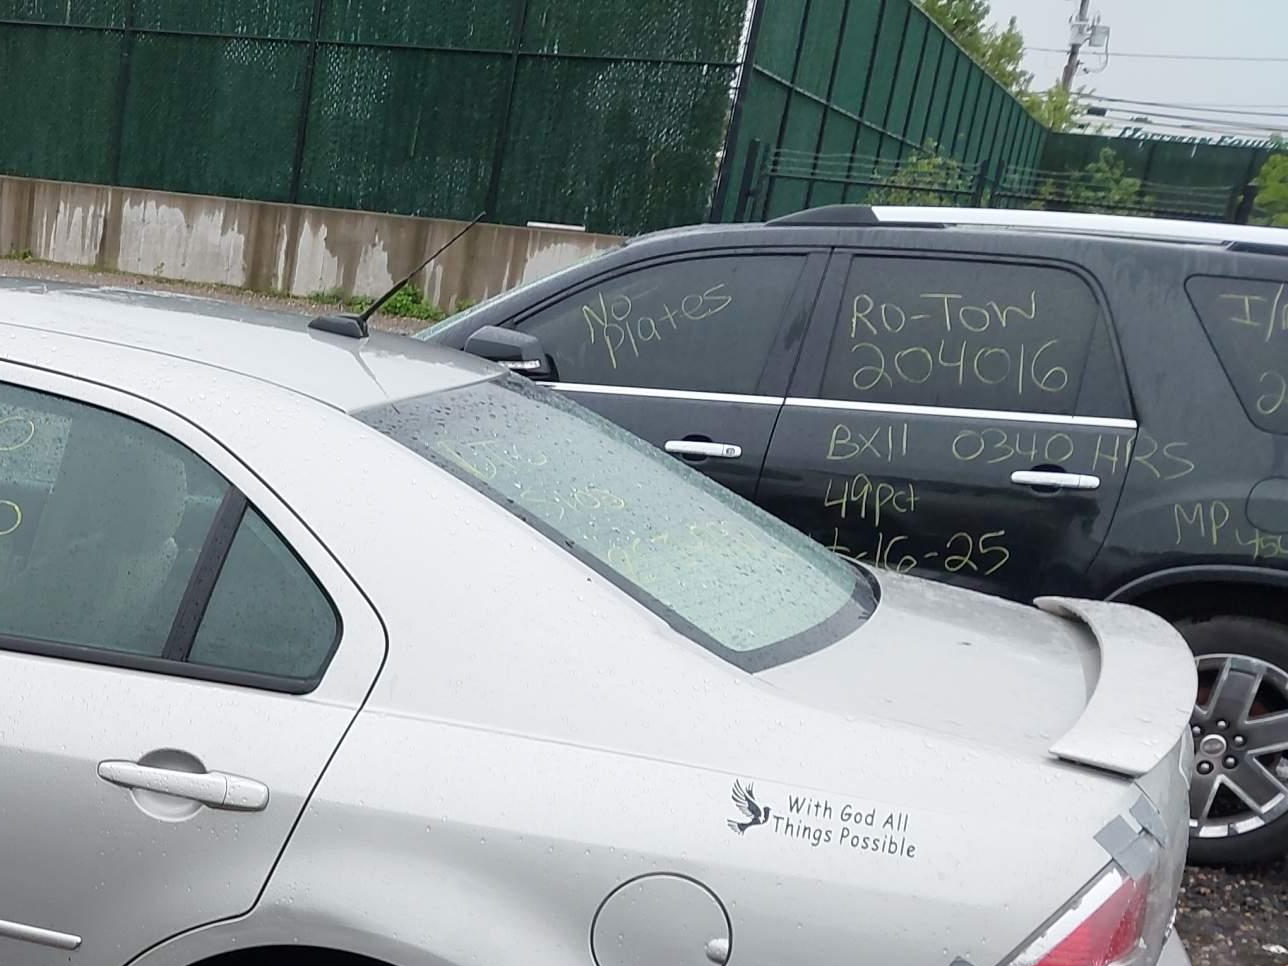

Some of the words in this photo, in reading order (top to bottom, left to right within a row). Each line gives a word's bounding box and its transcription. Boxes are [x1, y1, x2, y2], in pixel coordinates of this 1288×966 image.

[851, 339, 1067, 394] 204016
[952, 428, 1074, 463] 0340
[1092, 435, 1194, 479] HRS
[1174, 500, 1230, 545] MP
[773, 814, 833, 847] Things
[839, 827, 917, 858] Possible
[788, 794, 833, 819] With
[840, 804, 876, 827] God
[882, 813, 909, 833] All
